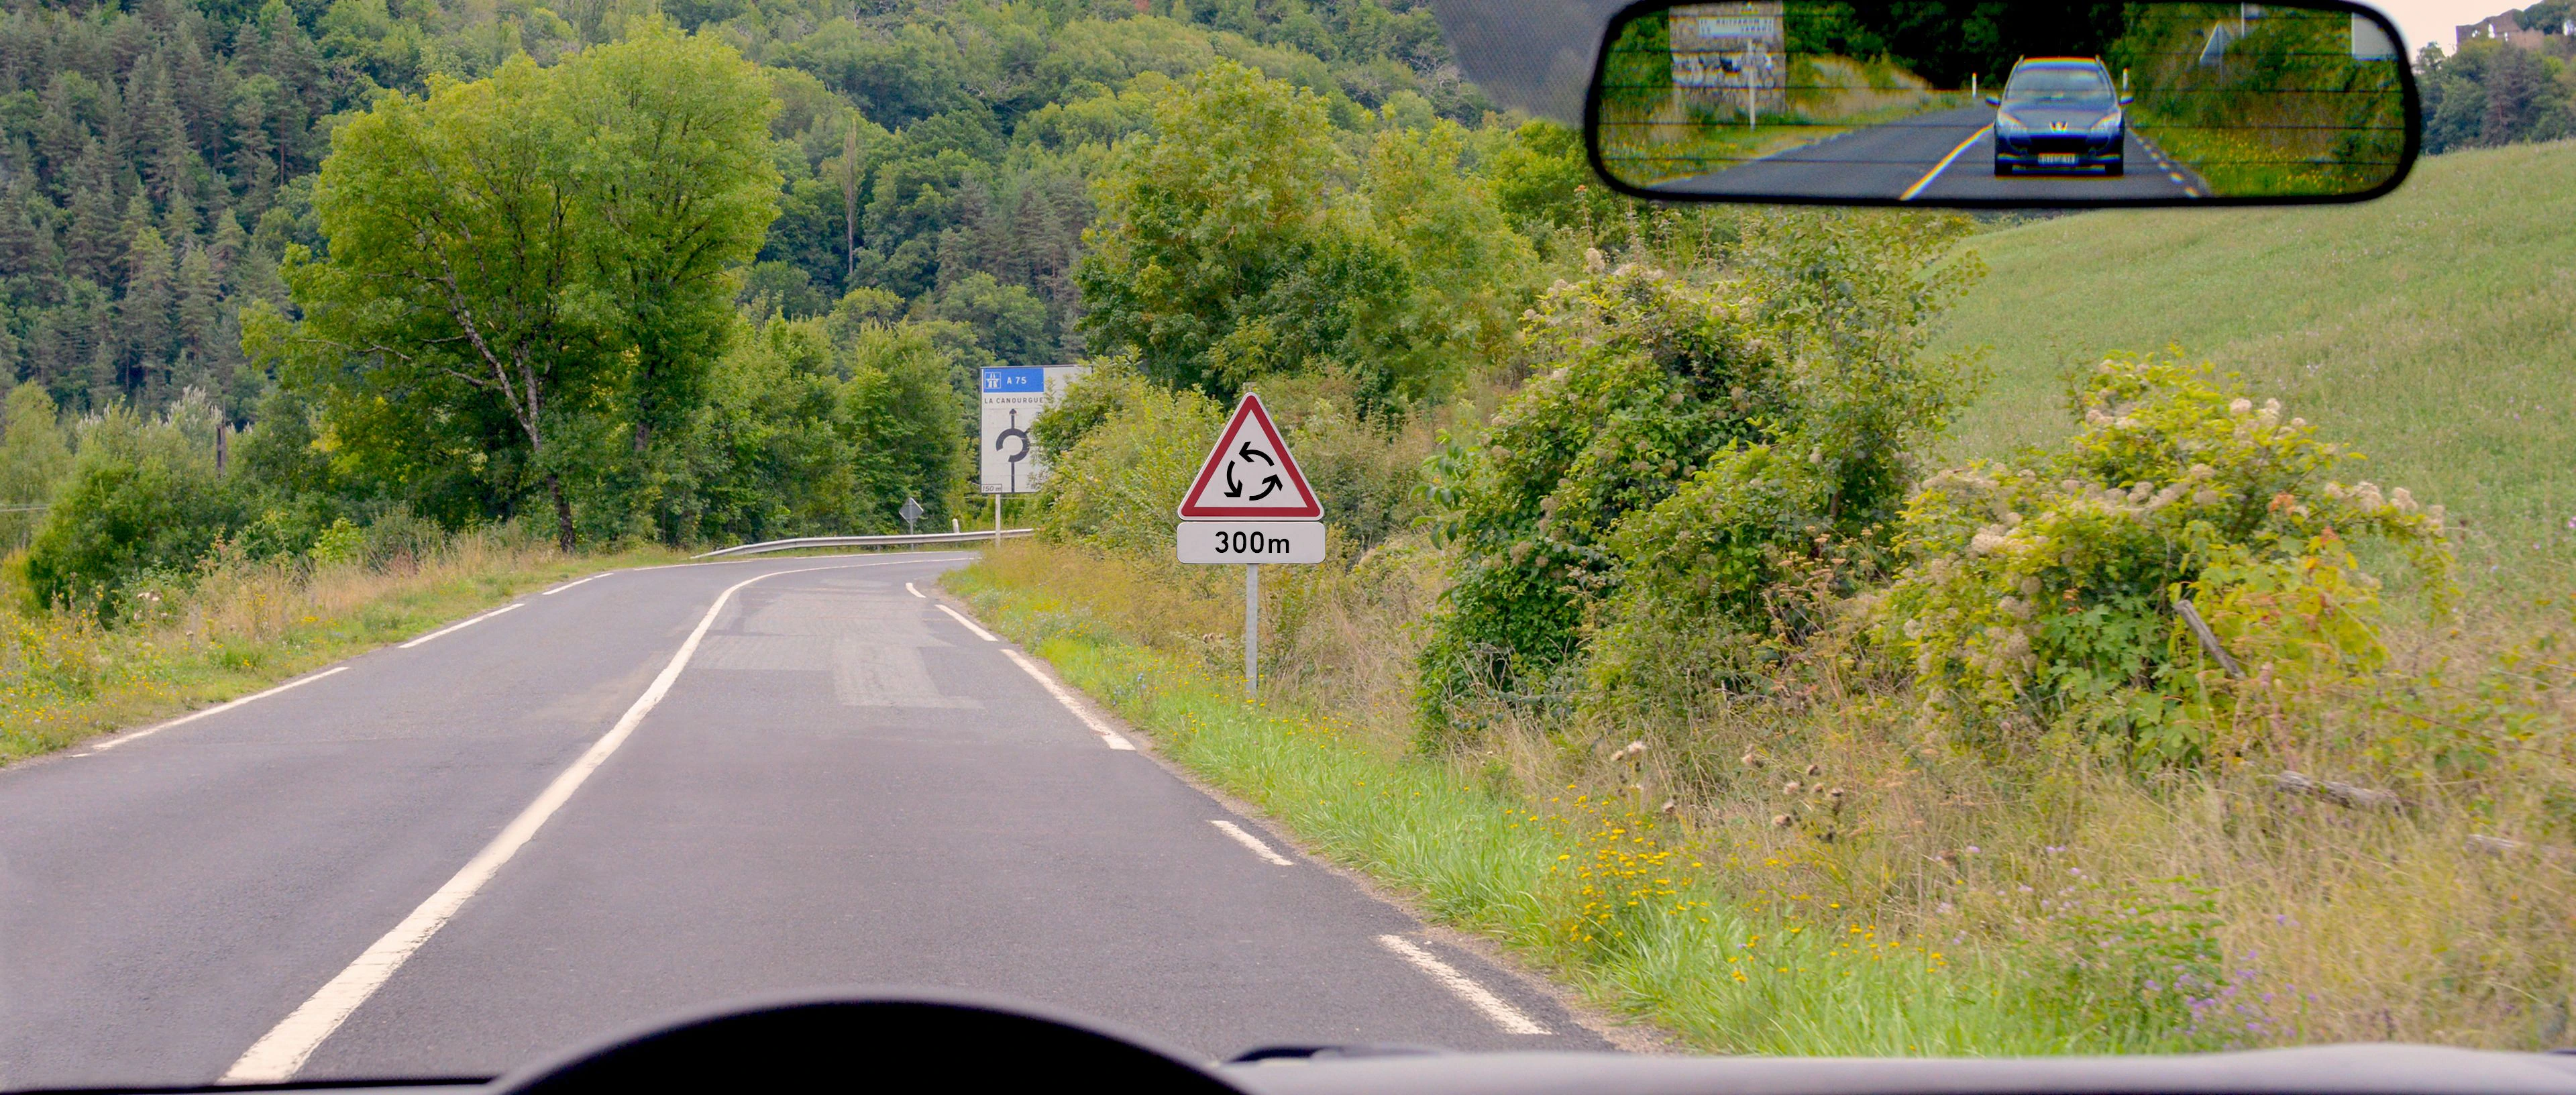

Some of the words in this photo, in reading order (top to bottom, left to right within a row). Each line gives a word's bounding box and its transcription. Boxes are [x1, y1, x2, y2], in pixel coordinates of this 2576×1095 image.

[1007, 376, 1012, 384] A
[1016, 376, 1027, 384] 75
[1215, 531, 1290, 554] 300m
